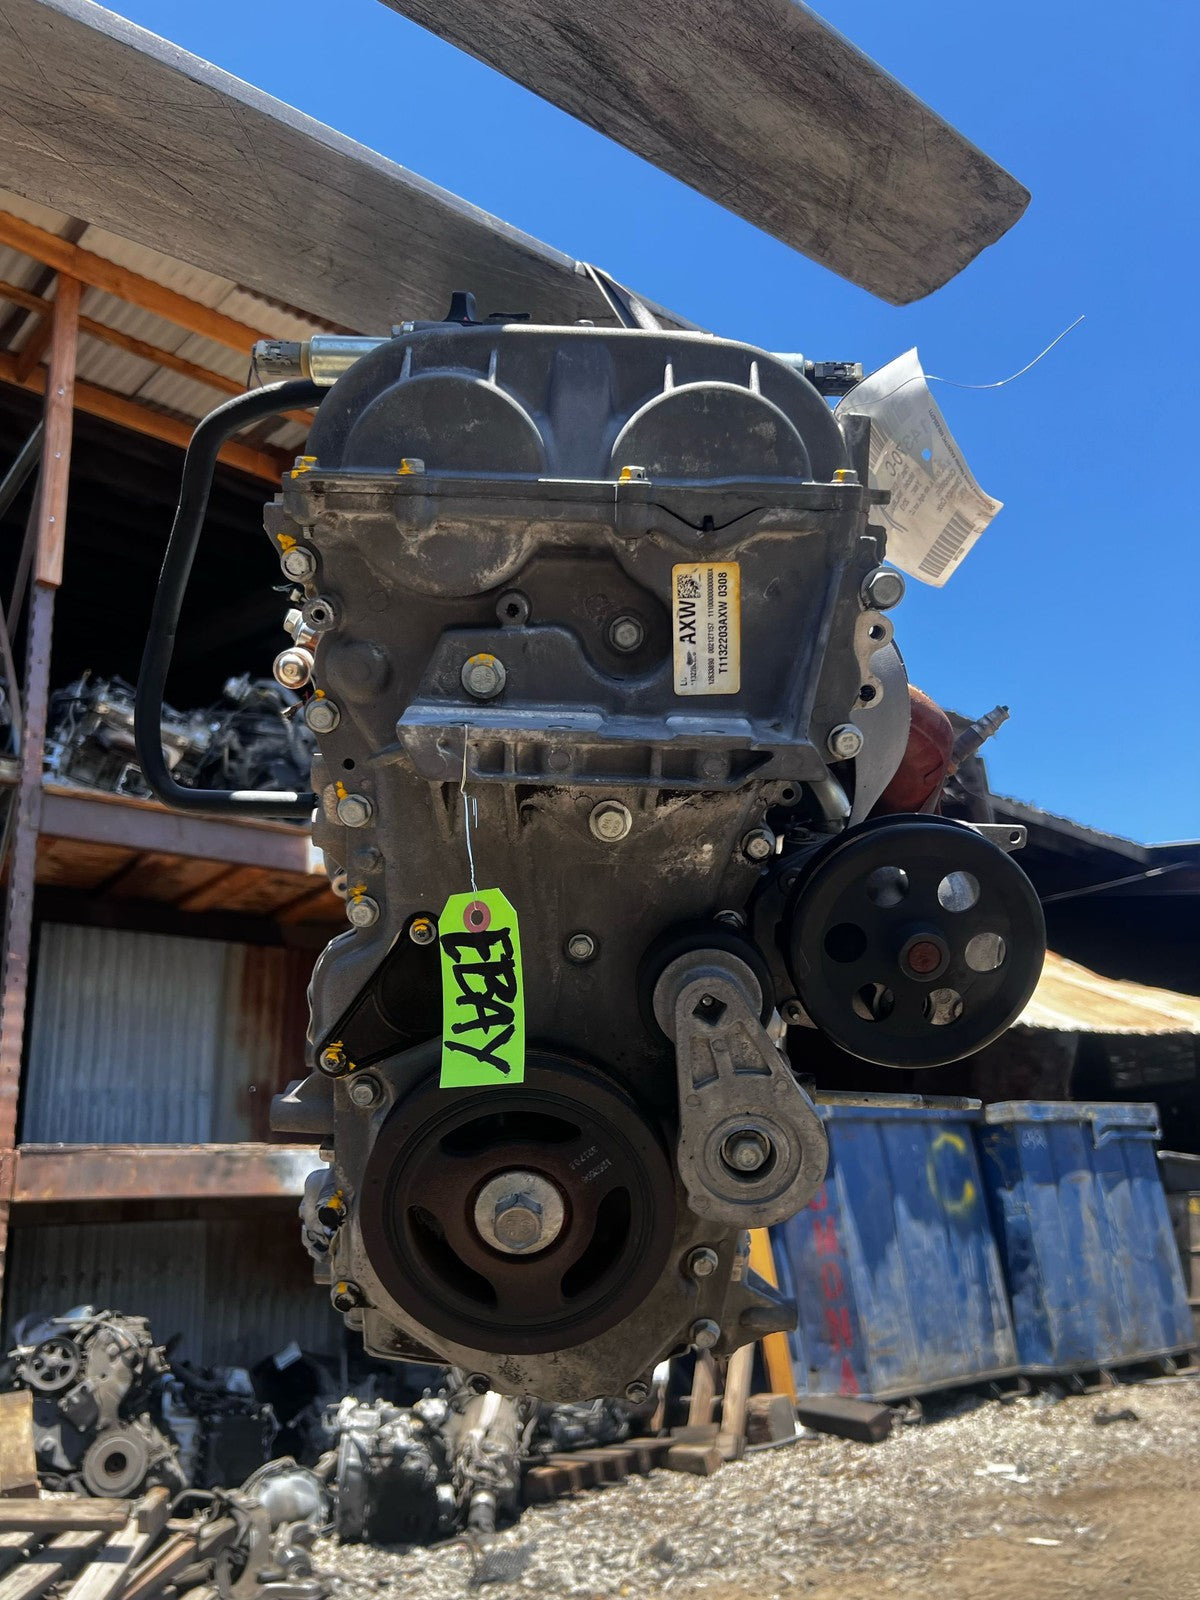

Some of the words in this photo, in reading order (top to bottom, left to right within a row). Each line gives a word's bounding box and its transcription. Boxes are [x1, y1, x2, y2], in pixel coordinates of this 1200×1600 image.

[718, 572, 728, 597] 0308
[679, 600, 696, 645] AXW
[718, 602, 728, 674] T1132203AXW
[440, 927, 518, 1078] EBAY
